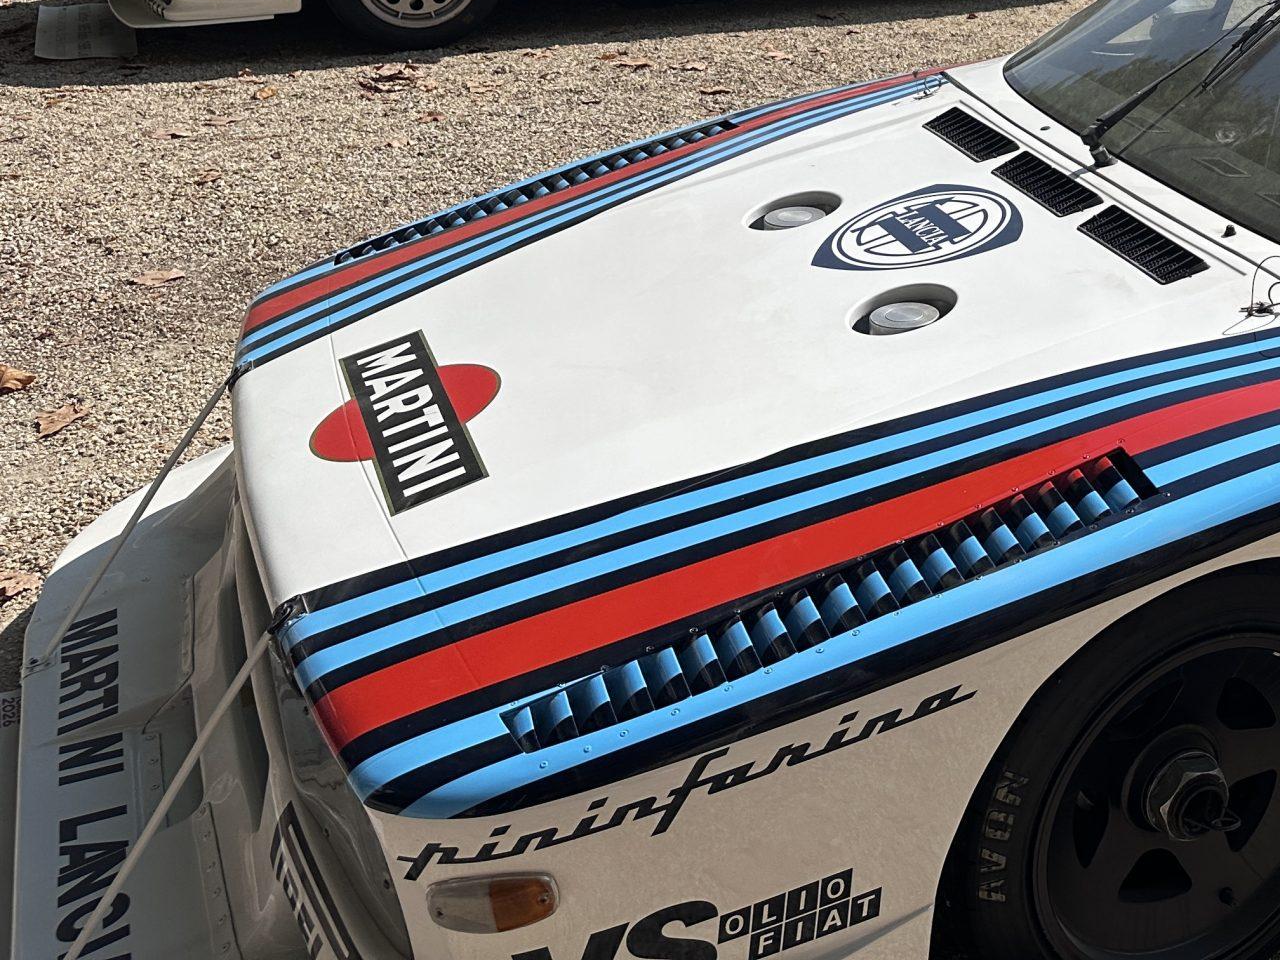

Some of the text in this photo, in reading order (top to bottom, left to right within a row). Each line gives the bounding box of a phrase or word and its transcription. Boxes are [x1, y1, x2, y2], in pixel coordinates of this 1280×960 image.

[895, 210, 949, 247] LANCIA
[357, 341, 466, 497] MARTINI
[2, 698, 16, 727] 2026
[56, 608, 133, 960] MARTINI LANC
[397, 684, 978, 881] pininfarina
[270, 800, 366, 960] PIRE
[724, 878, 845, 936] OLIO
[757, 893, 876, 955] FIAT
